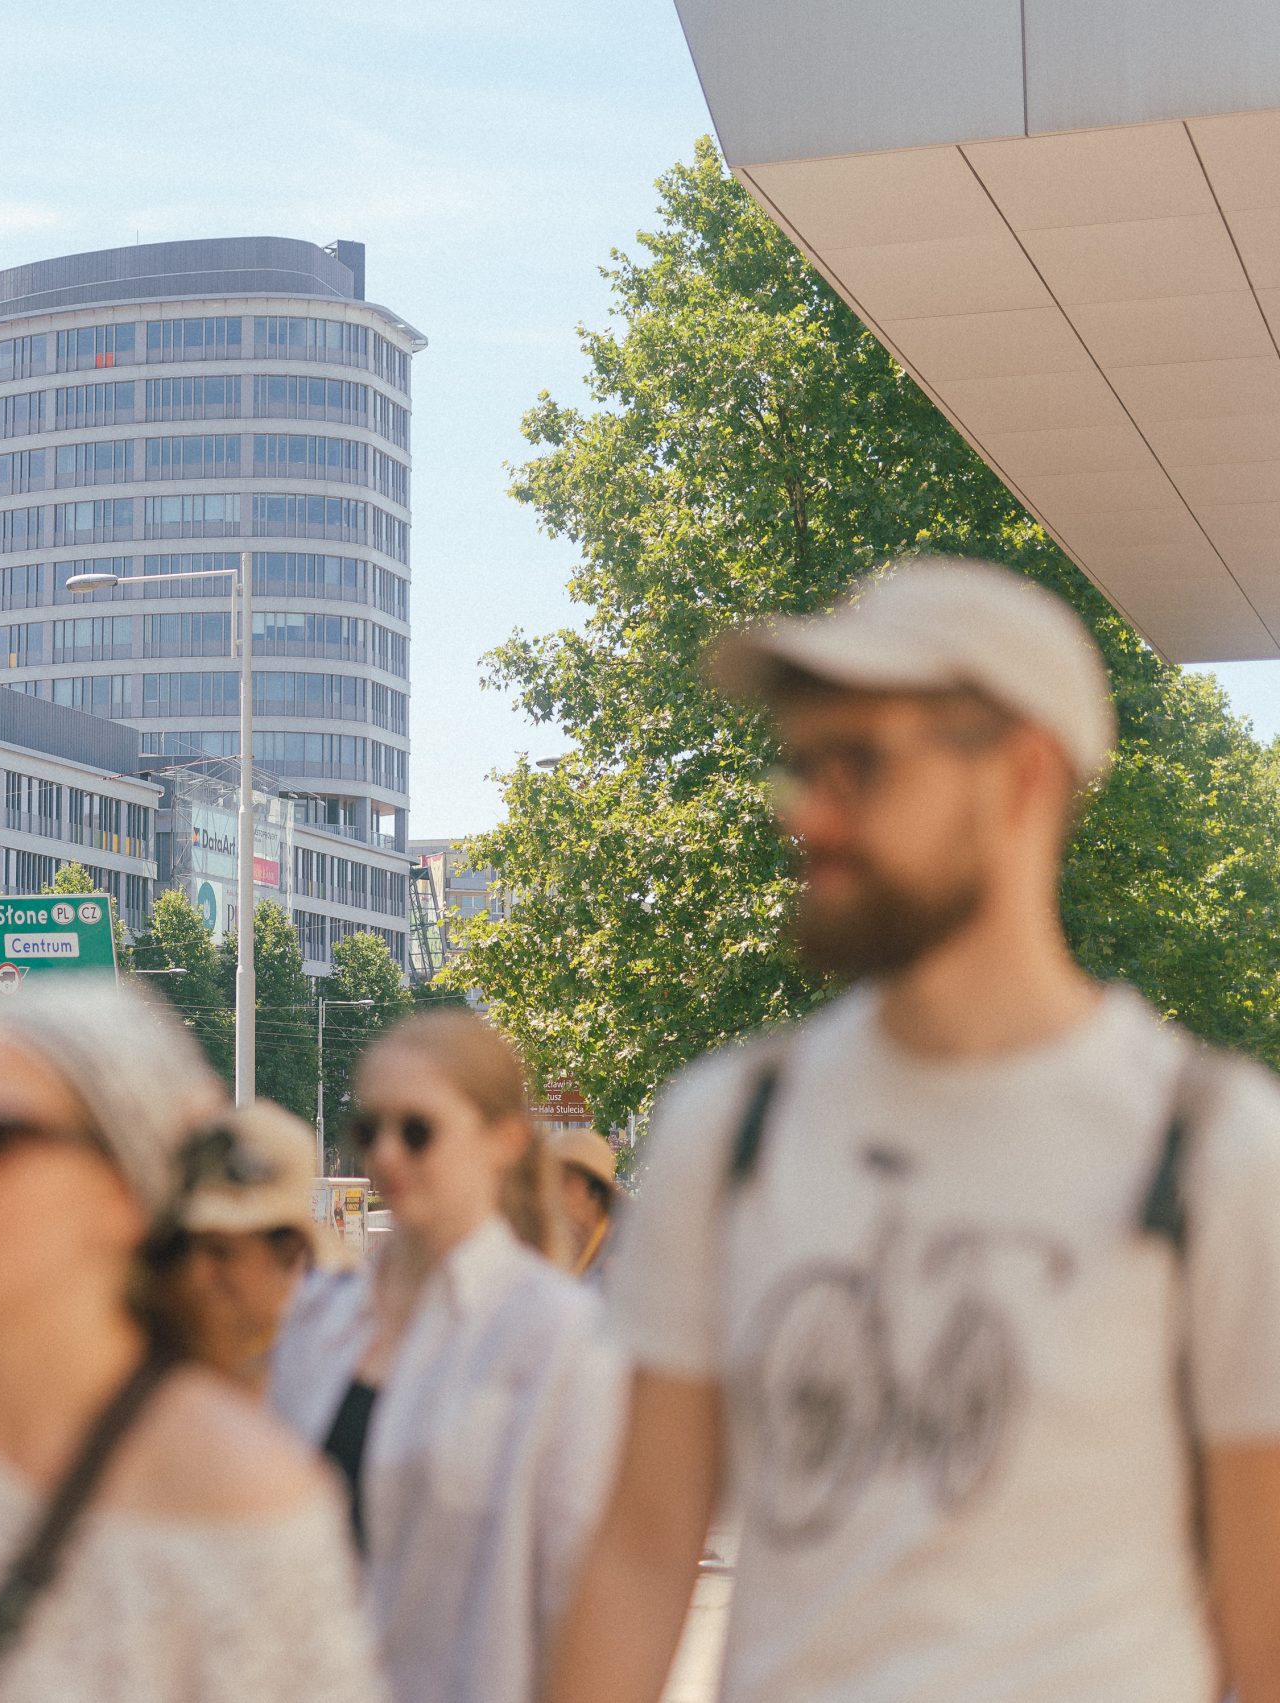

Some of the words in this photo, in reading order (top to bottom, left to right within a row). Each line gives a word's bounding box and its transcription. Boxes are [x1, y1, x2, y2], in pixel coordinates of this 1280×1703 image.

[202, 829, 236, 855] DataArt
[57, 907, 69, 920] PL
[81, 906, 97, 920] CZ
[11, 938, 72, 953] Centrum
[538, 1105, 554, 1114] Hala
[556, 1104, 584, 1114] Stulecia
